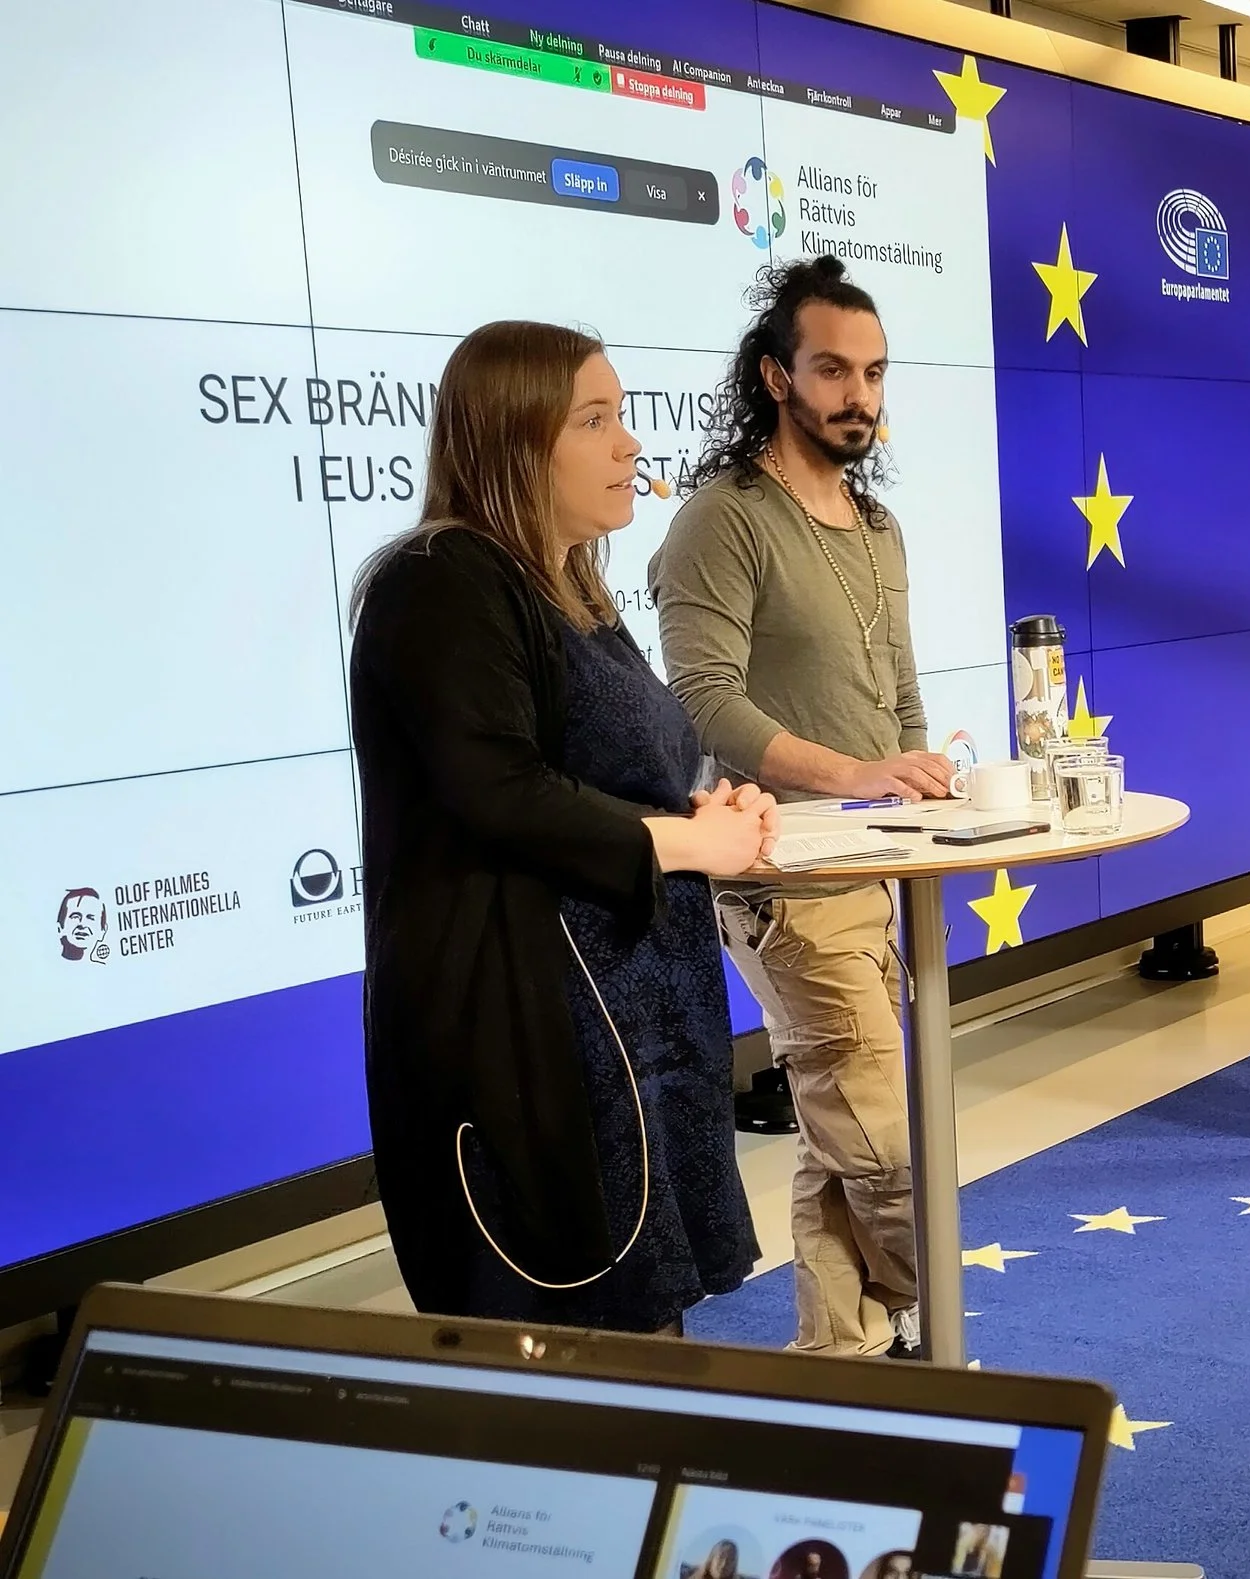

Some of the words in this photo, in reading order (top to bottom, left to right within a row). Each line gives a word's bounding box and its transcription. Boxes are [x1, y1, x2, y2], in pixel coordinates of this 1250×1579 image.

[461, 15, 490, 33] Chatt
[529, 29, 544, 43] Ny
[546, 34, 584, 55] delning
[467, 46, 482, 62] Du
[485, 49, 541, 74] skärmdelar
[598, 44, 626, 61] Pausa
[627, 48, 662, 72] delning
[672, 59, 682, 73] AI
[683, 61, 732, 84] Companion
[629, 78, 660, 98] Stoppa
[661, 84, 694, 105] delning
[747, 75, 784, 95] Anteckna
[807, 88, 852, 108] Fjärrkontroll
[881, 103, 902, 119] Appar
[928, 114, 942, 127] Mer
[389, 146, 432, 169] Désirée
[435, 153, 459, 173] gick
[461, 157, 473, 174] in
[482, 159, 547, 184] väntrummet
[564, 171, 595, 194] Släpp
[596, 178, 608, 193] in
[646, 184, 667, 201] Visa
[797, 165, 853, 195] Allians
[857, 174, 878, 199] för
[800, 197, 856, 227] Rättvis
[801, 230, 944, 274] Klimatomställning
[1161, 278, 1230, 303] Europaparlamentet
[199, 373, 292, 425] SEX
[293, 455, 303, 502] I
[319, 455, 415, 502] EU:S
[115, 882, 151, 906] OLOF
[155, 871, 210, 900] PALMES
[118, 890, 241, 932] INTERNATIONELLA
[293, 908, 333, 924] FUTURE
[337, 903, 362, 916] EART
[120, 928, 174, 957] CENTER
